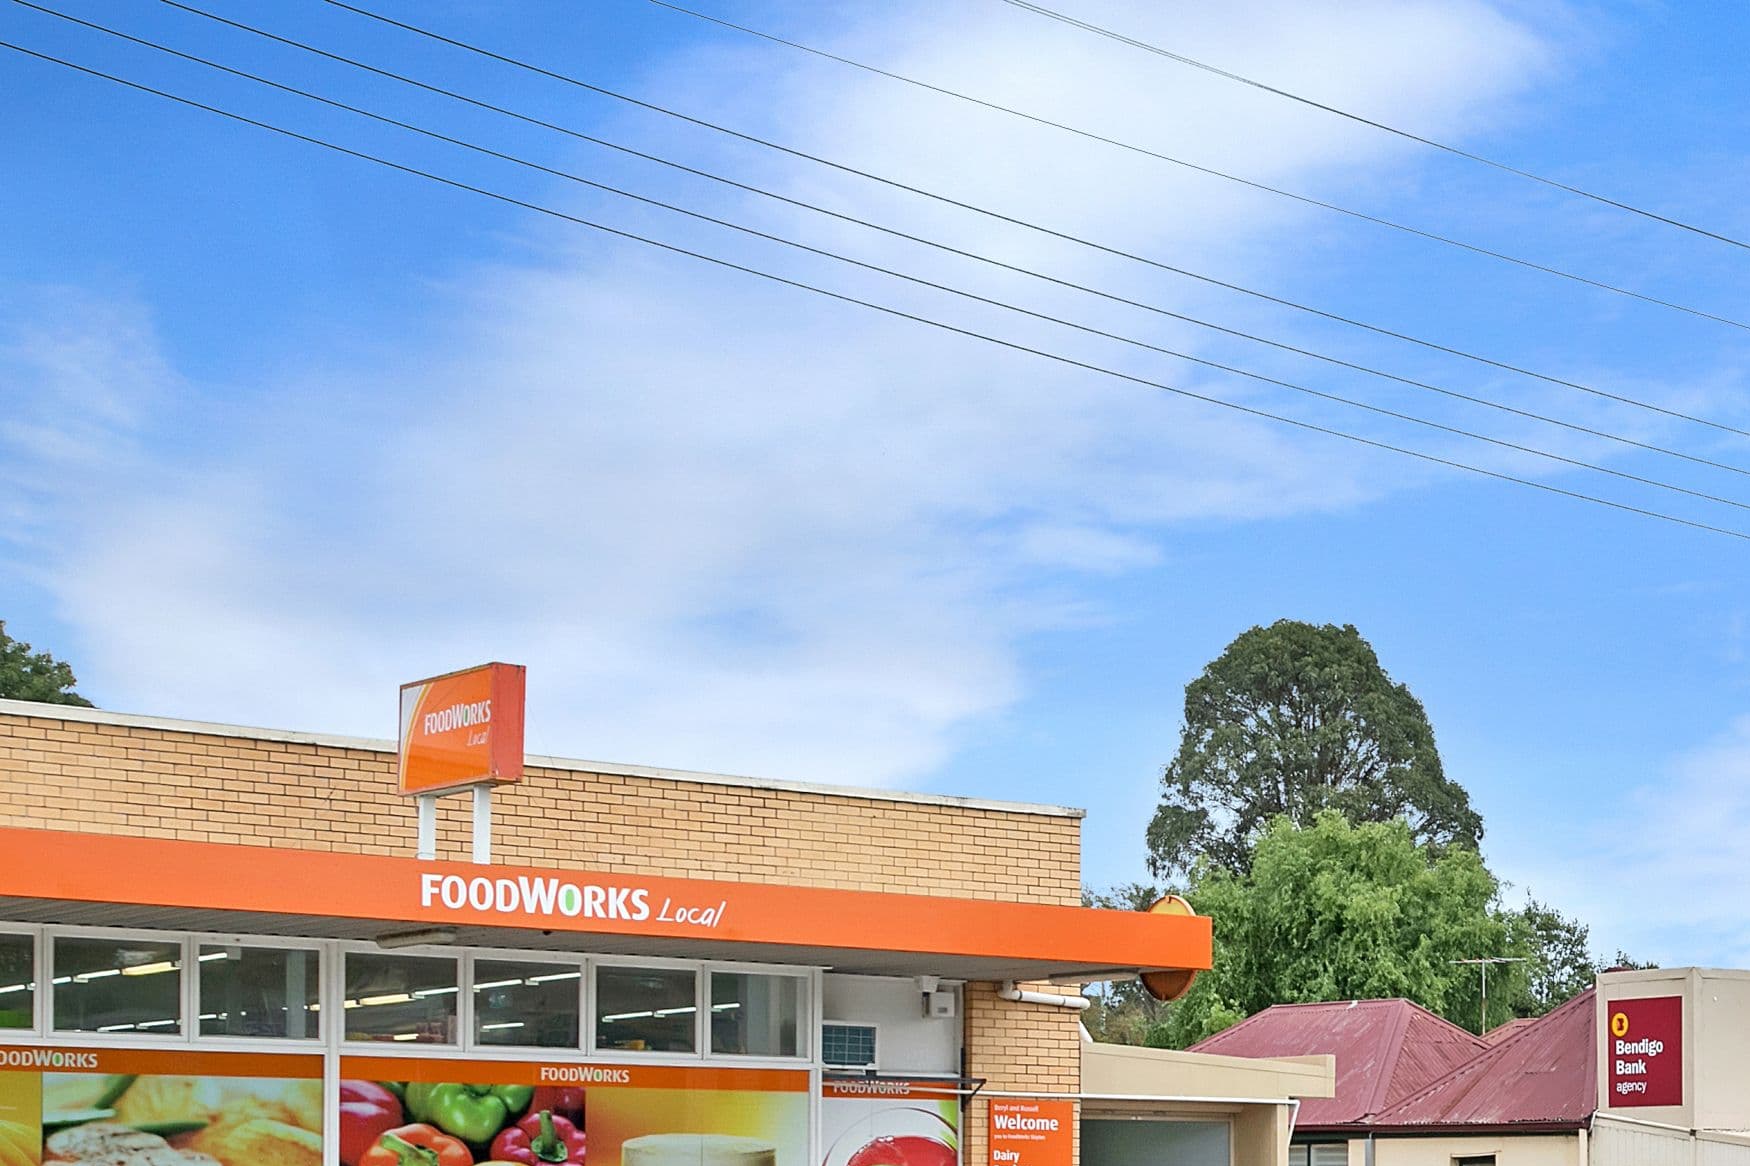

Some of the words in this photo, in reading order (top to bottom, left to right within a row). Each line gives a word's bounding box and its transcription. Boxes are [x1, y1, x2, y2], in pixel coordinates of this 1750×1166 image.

[424, 699, 492, 737] FOODWORKS
[467, 726, 491, 747] Local
[421, 873, 650, 920] FOODWORKS
[656, 897, 727, 928] Local
[1615, 1038, 1664, 1057] Bendigo
[540, 1066, 630, 1083] FOODWORKS
[1615, 1059, 1647, 1075] Bank
[1616, 1081, 1647, 1095] agency
[993, 1113, 1059, 1131] Welcome
[993, 1150, 1020, 1164] Dairy
